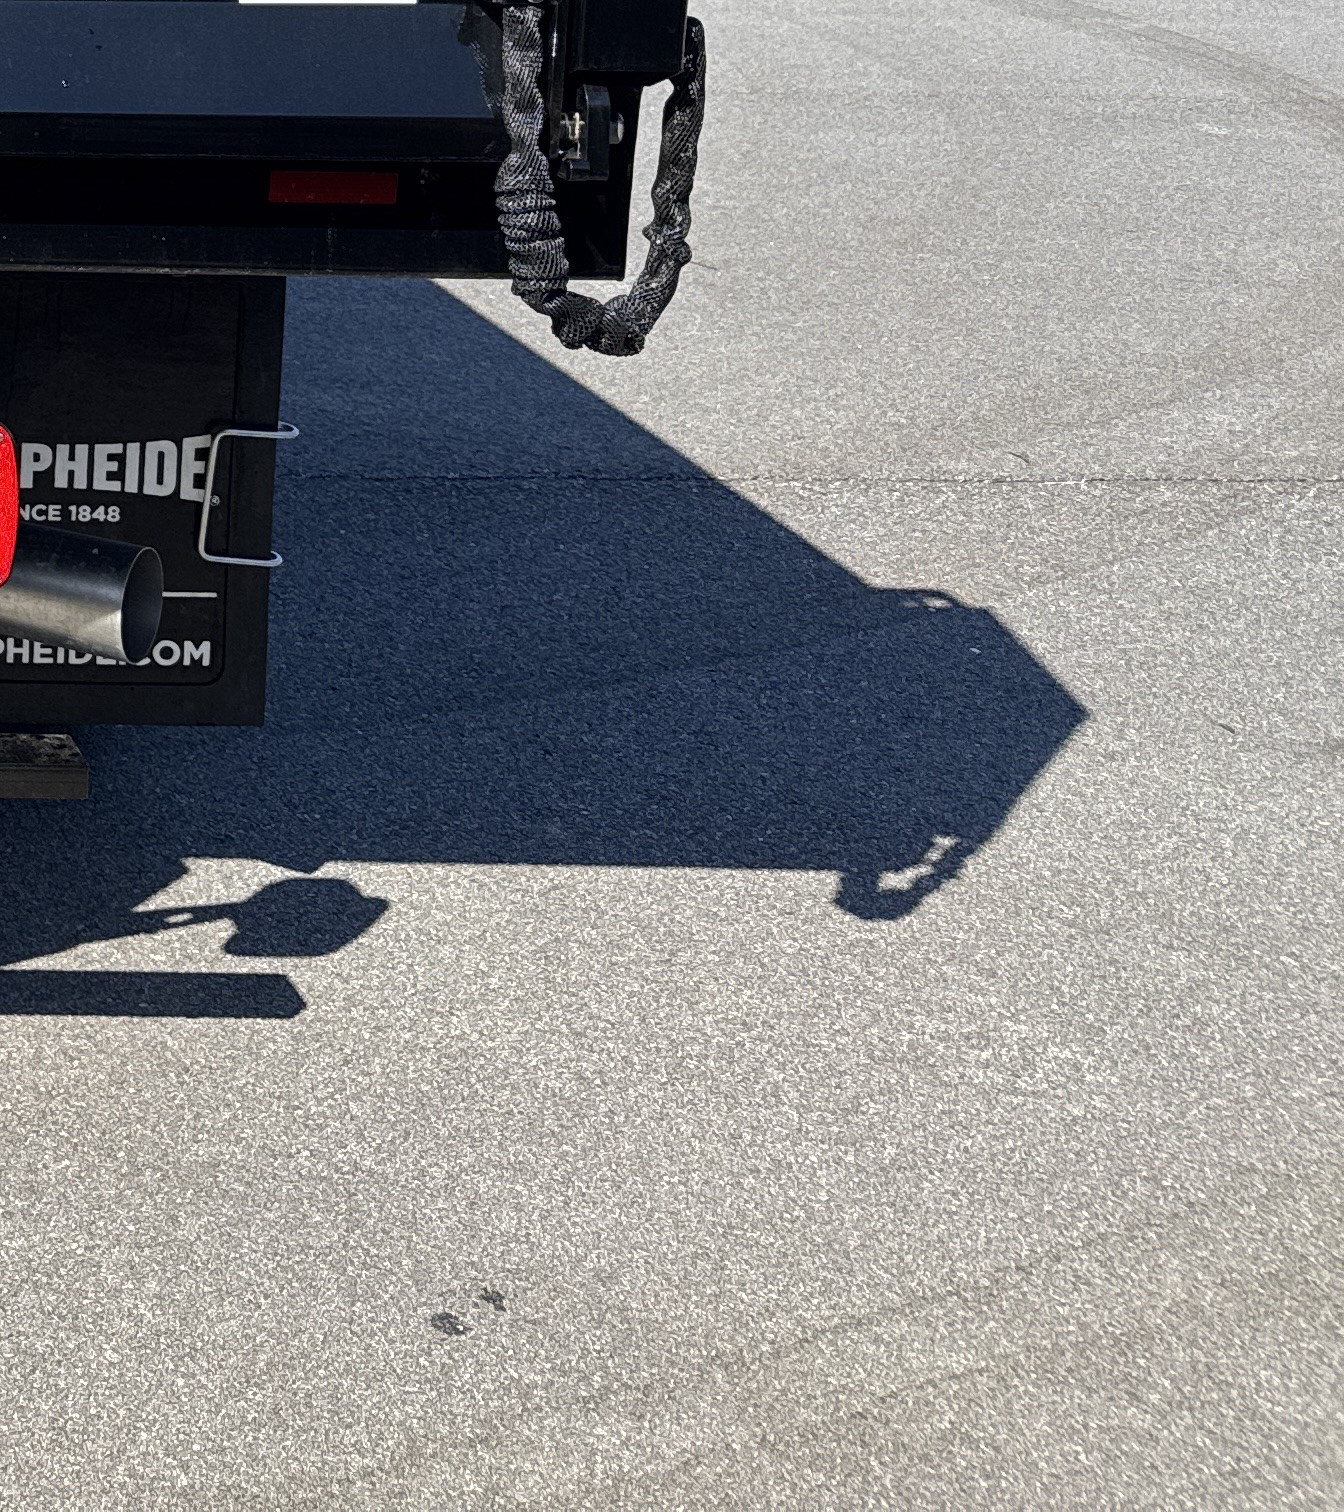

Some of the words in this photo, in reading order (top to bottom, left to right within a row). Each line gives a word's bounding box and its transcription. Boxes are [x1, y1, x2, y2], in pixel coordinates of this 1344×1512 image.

[20, 434, 211, 502] PHEIDE
[20, 504, 61, 521] NCE
[69, 505, 121, 522] 1848
